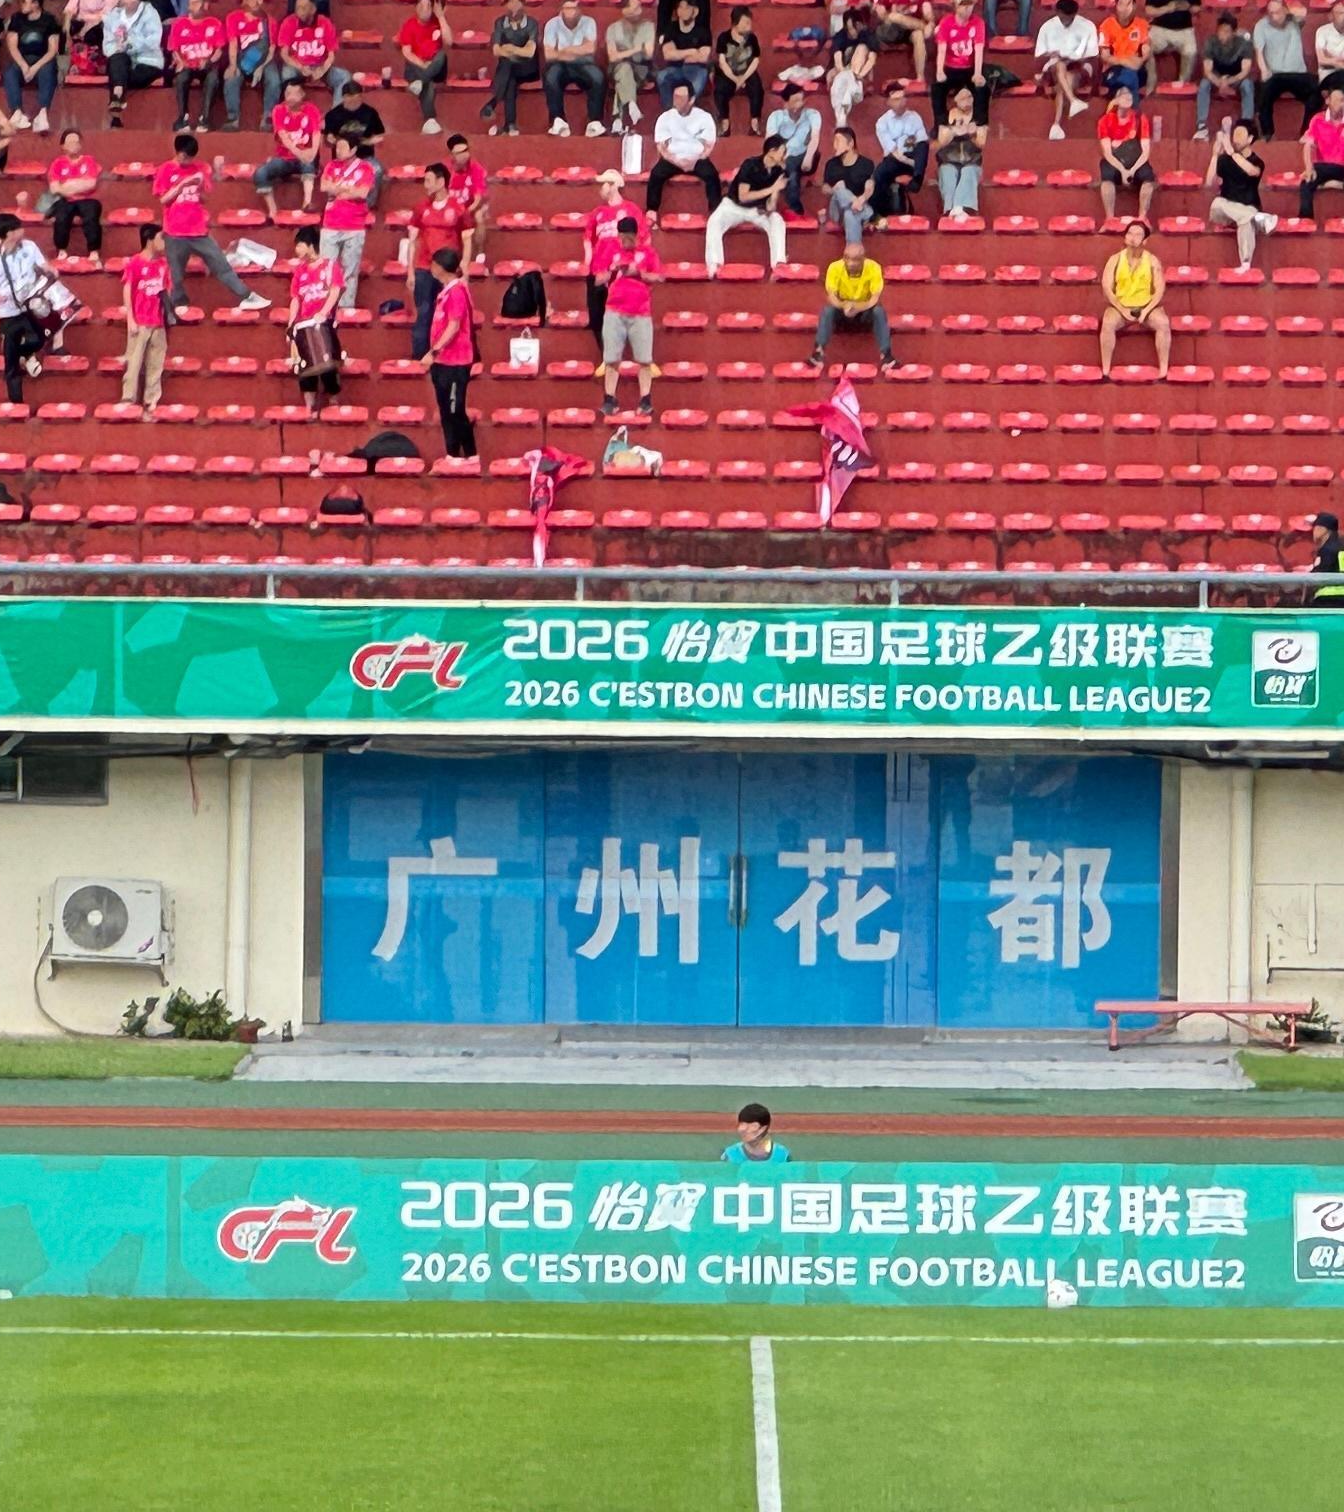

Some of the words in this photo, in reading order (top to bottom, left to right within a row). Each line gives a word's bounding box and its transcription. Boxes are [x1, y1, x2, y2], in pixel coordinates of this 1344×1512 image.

[502, 618, 650, 662] 2026
[504, 680, 581, 707] 2026
[589, 680, 744, 709] C'ESTBON
[753, 682, 887, 711] CHINESE
[895, 683, 1062, 713] FOOTBALL
[1069, 685, 1212, 714] LEAGUE2
[371, 835, 1113, 970] 广州花都
[400, 1180, 575, 1231] 2026
[401, 1251, 492, 1284] 2026
[501, 1251, 687, 1285] C'ESTBON
[698, 1253, 859, 1287] CHINESE
[1076, 1256, 1247, 1289] LEAGUE2
